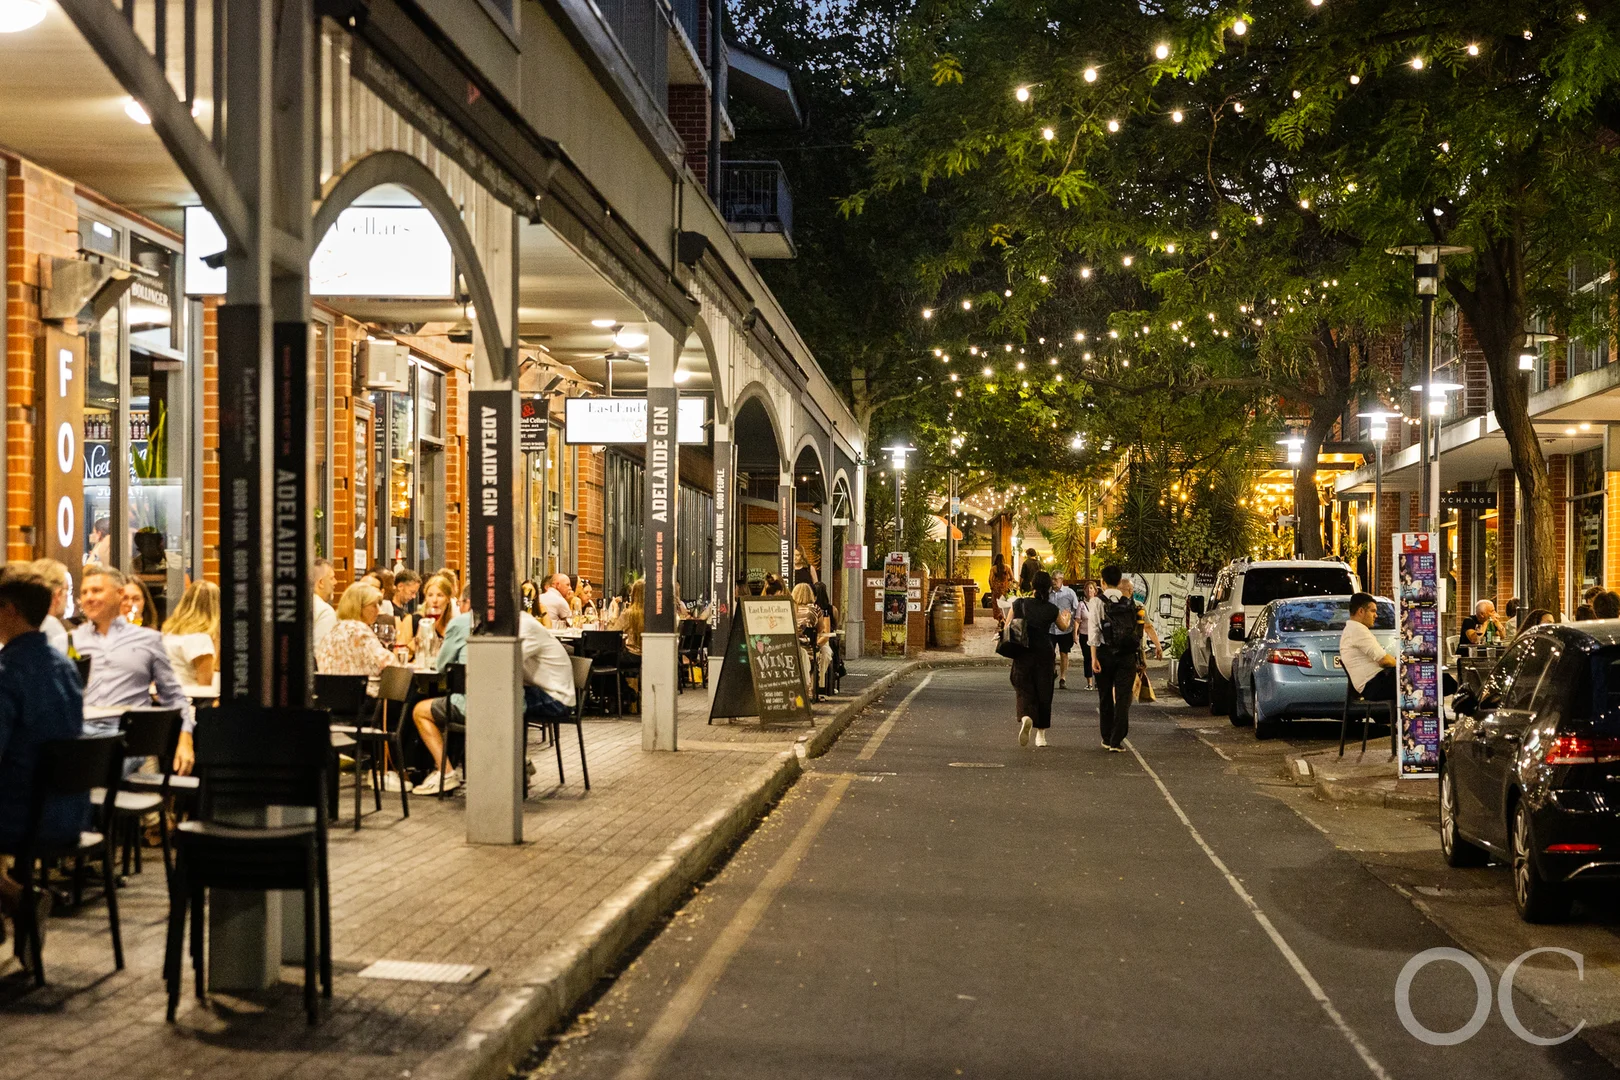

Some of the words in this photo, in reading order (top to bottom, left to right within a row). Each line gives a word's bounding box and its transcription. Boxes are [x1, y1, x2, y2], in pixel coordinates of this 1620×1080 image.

[653, 406, 669, 436] GIN
[481, 405, 498, 486] ADELAIDE
[652, 439, 668, 523] ADELAIDE
[482, 488, 498, 517] GIN
[716, 492, 724, 509] GOOD
[276, 468, 297, 579] ADELAIDE
[715, 530, 724, 547] GOOD
[780, 538, 789, 577] ADELAIDE
[715, 567, 723, 583] GOOD
[276, 584, 297, 623] GIN
[748, 606, 760, 614] East
[760, 606, 771, 614] End
[771, 605, 789, 613] Cellars
[757, 652, 796, 671] WINE
[761, 671, 796, 679] EVENT
